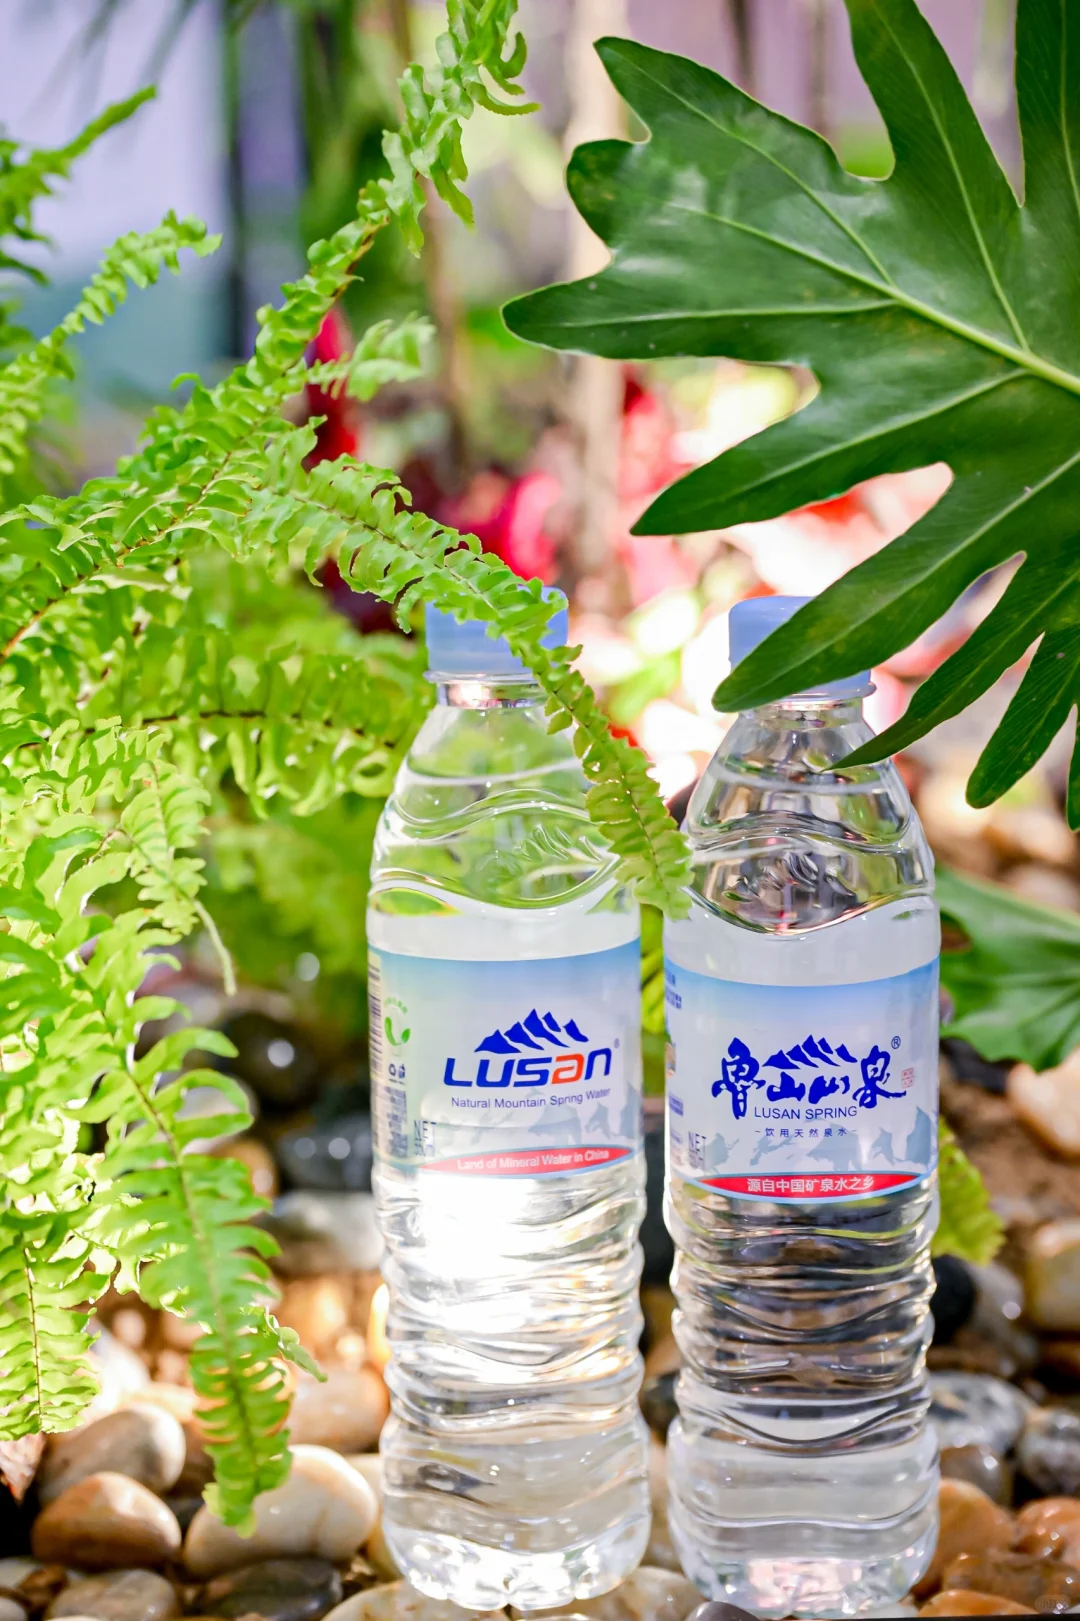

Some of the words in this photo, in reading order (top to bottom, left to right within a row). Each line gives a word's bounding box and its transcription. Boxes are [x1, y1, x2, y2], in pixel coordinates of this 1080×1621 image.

[451, 1096, 491, 1109] Natural
[494, 1097, 546, 1109] Mountain
[550, 1095, 583, 1107] Spring
[585, 1087, 611, 1100] Water
[754, 1106, 801, 1120] LUSAN
[805, 1105, 858, 1120] SPRING
[764, 1127, 848, 1138] 饮用天然泉水
[457, 1159, 484, 1171] Land
[486, 1157, 498, 1169] of
[500, 1155, 540, 1168] Mineral
[542, 1152, 573, 1166] Water
[574, 1152, 583, 1163] in
[584, 1149, 610, 1162] China
[747, 1175, 875, 1193] 源自中国矿泉水之乡
